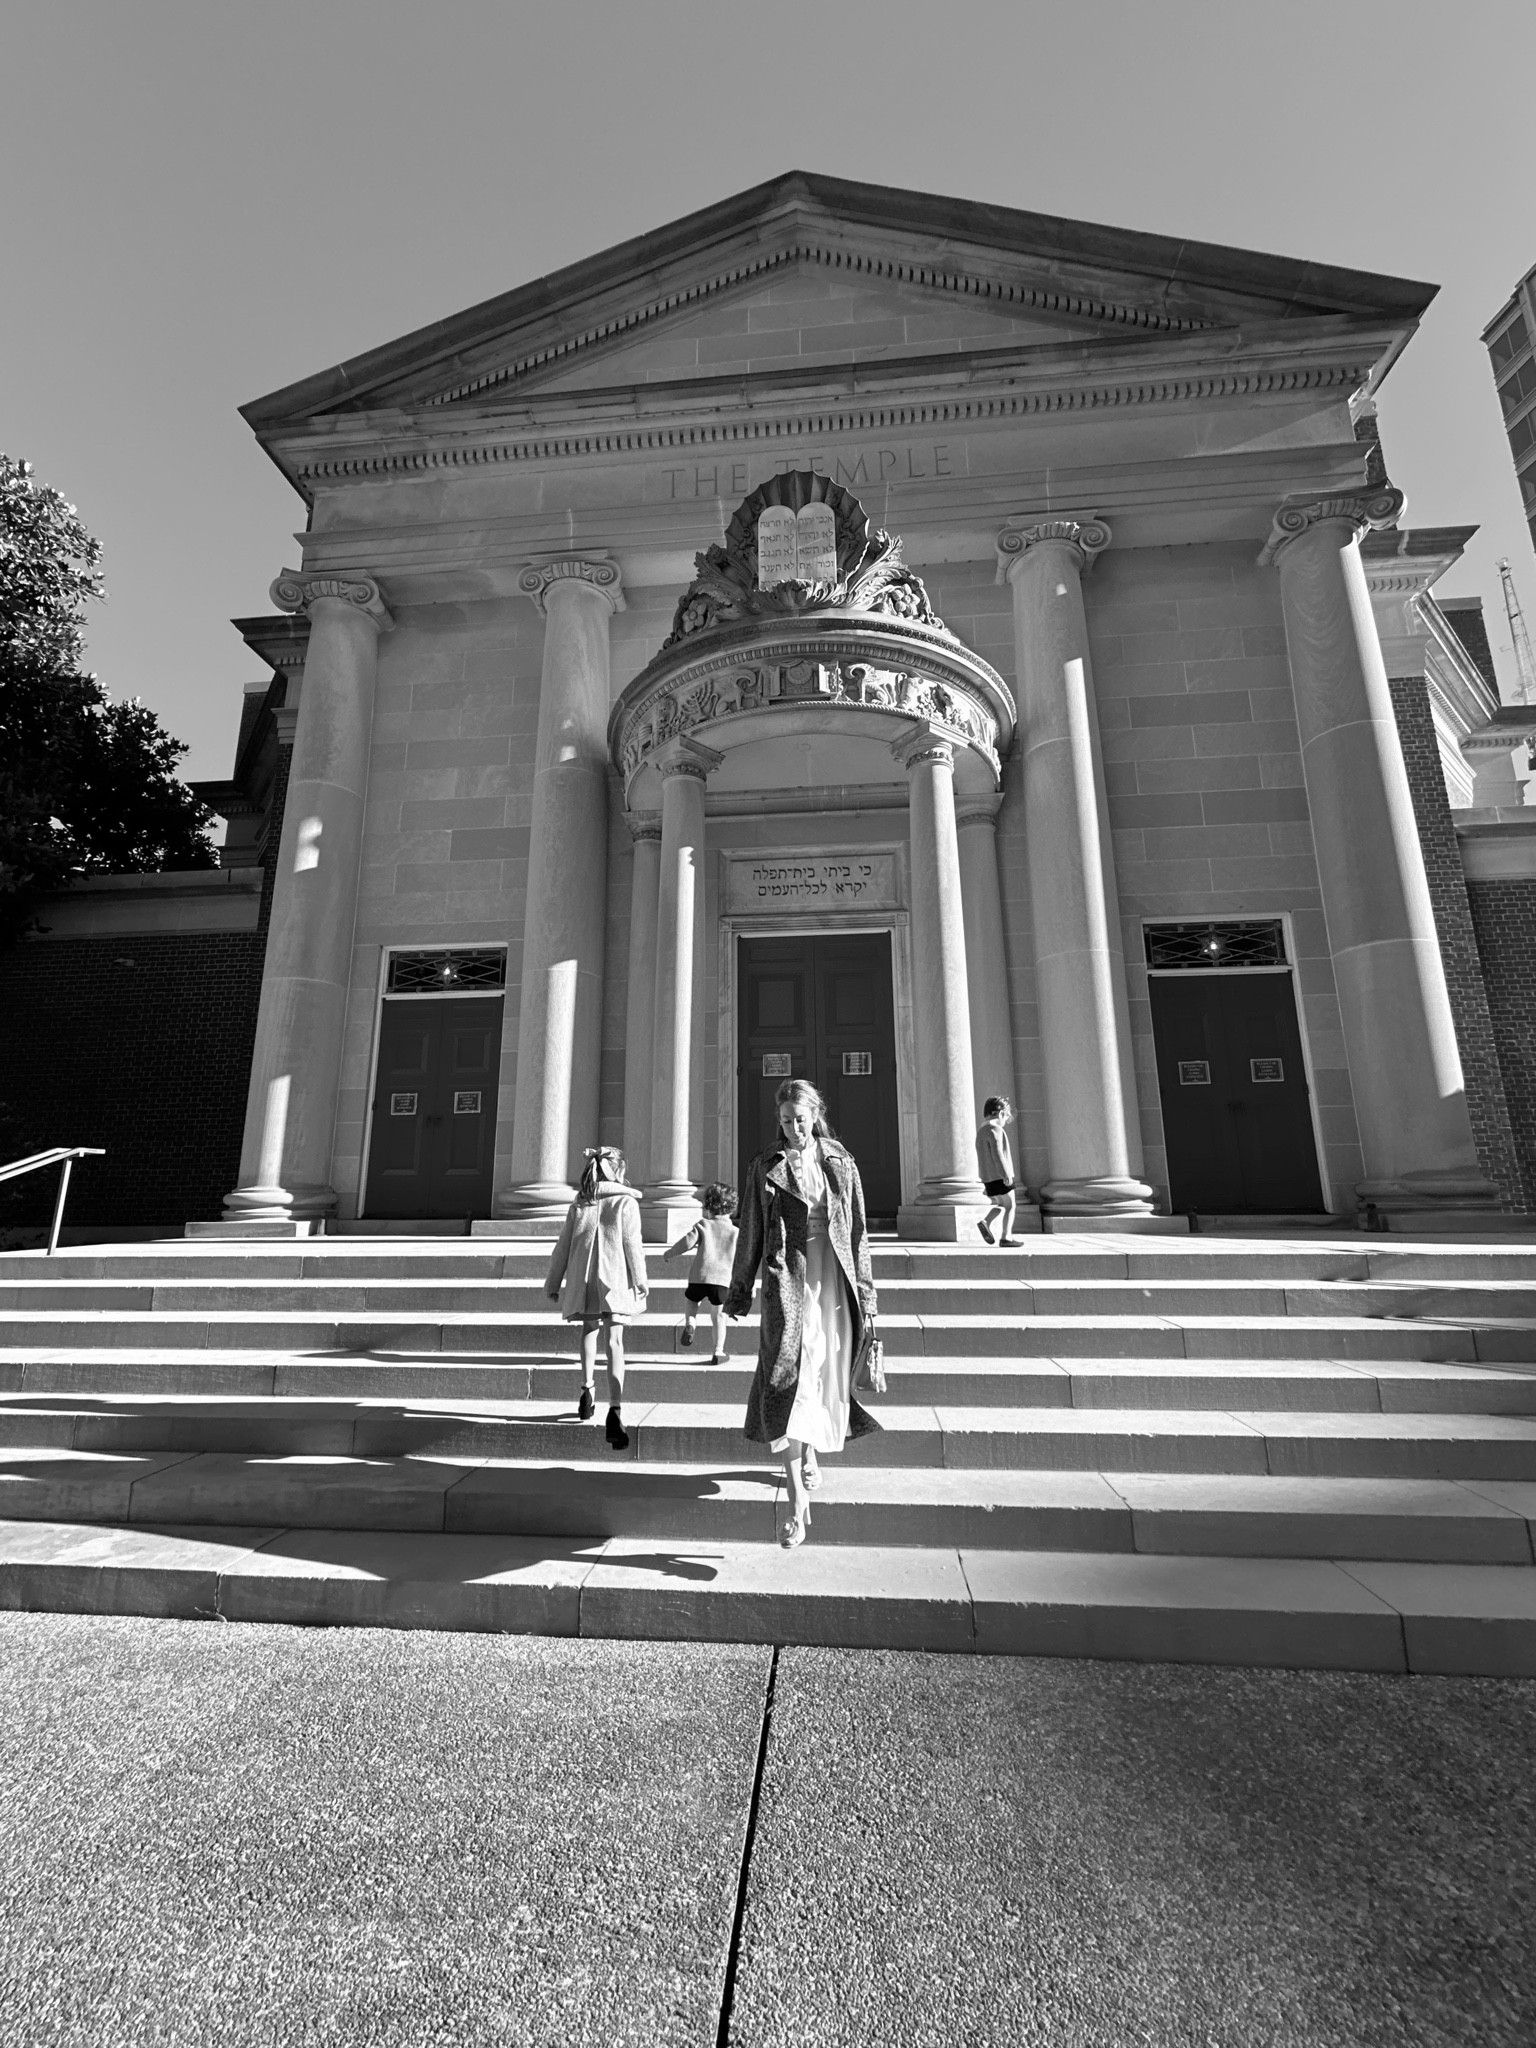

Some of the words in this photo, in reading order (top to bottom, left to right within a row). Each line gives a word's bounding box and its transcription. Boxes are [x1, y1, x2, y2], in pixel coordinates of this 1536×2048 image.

[662, 463, 747, 498] THE
[783, 517, 794, 527] לא
[783, 532, 794, 542] לא
[822, 528, 834, 538] לא
[783, 545, 794, 556] לא
[823, 543, 834, 553] לא
[783, 560, 795, 571] לא
[816, 560, 834, 568] זכור
[823, 865, 851, 878] ביתי
[858, 864, 872, 876] כי
[834, 881, 867, 898] יקרא
